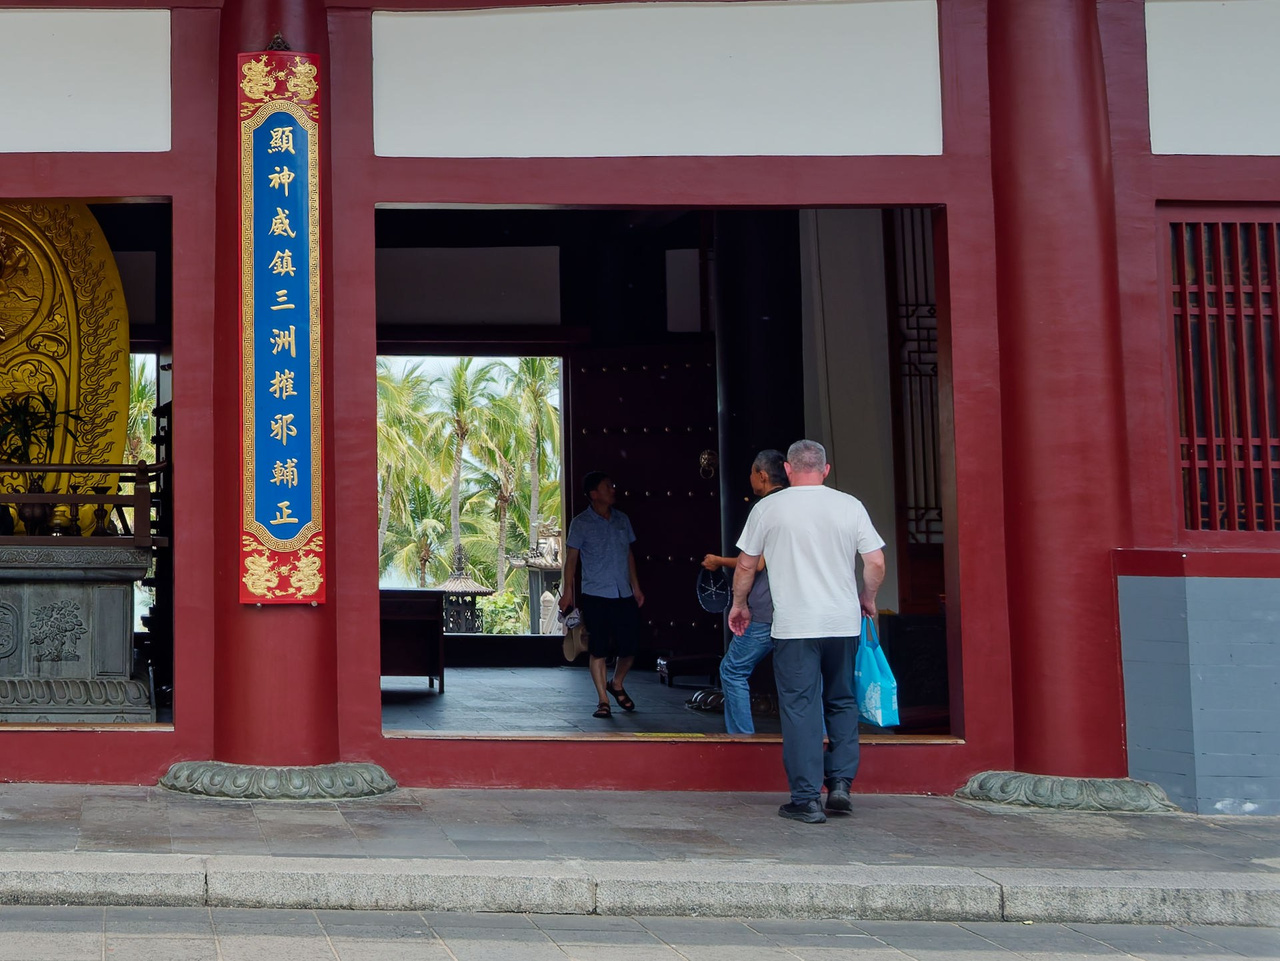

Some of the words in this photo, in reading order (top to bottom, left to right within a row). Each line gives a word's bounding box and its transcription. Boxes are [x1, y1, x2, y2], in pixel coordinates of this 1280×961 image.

[267, 126, 299, 526] 顯神威鎮三洲摧邪輔正
